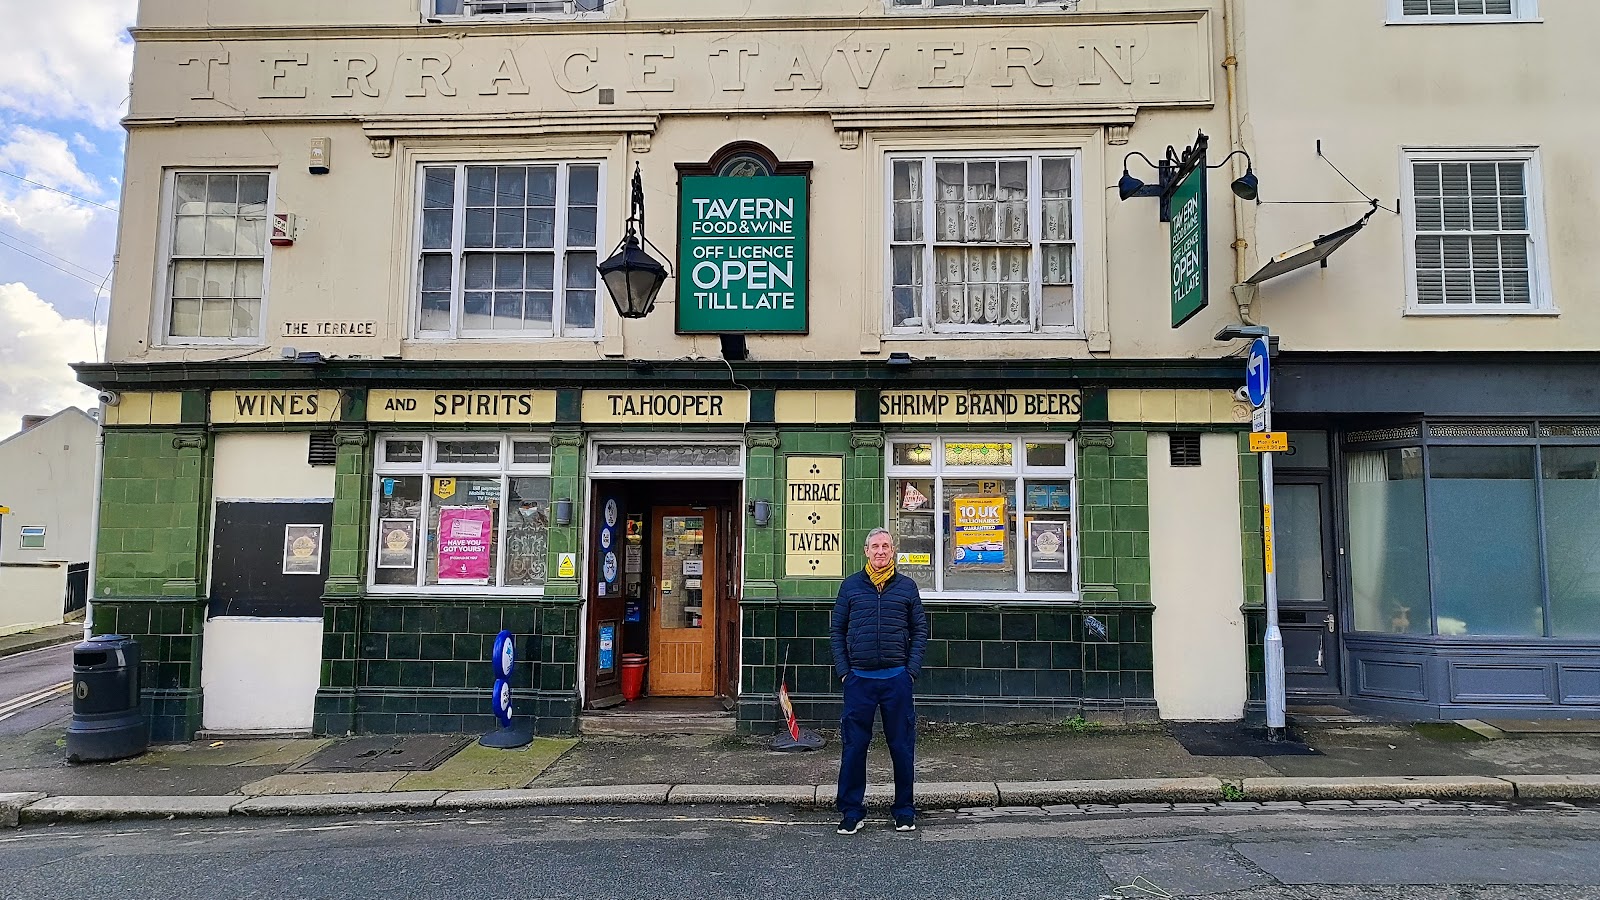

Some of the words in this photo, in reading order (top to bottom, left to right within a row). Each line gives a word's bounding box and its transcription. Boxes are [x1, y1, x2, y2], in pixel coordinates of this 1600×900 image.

[178, 47, 676, 100] TERRACE
[692, 198, 794, 220] TAVERN
[1172, 192, 1198, 232] TAVERN
[693, 246, 724, 259] OFF
[729, 246, 794, 259] LICENCE
[1173, 248, 1182, 263] OFF
[1182, 231, 1198, 254] LICENCE
[692, 260, 793, 290] OPEN
[1173, 244, 1199, 287] OPEN
[1174, 286, 1185, 303] TILL
[1185, 271, 1199, 294] LATE
[694, 292, 738, 309] TILL
[742, 292, 794, 309] LATE
[286, 323, 308, 334] THE
[317, 322, 372, 334] TERRACE
[236, 394, 318, 416] WINES
[384, 398, 417, 411] AND
[434, 394, 532, 416] SPIRITS
[880, 394, 949, 415] SHRIMP
[956, 394, 1018, 415] BRAND
[1024, 394, 1081, 415] BEERS
[789, 484, 840, 501] TERRACE
[960, 506, 976, 517] 10
[978, 506, 999, 517] UK
[789, 533, 839, 551] TAVERN
